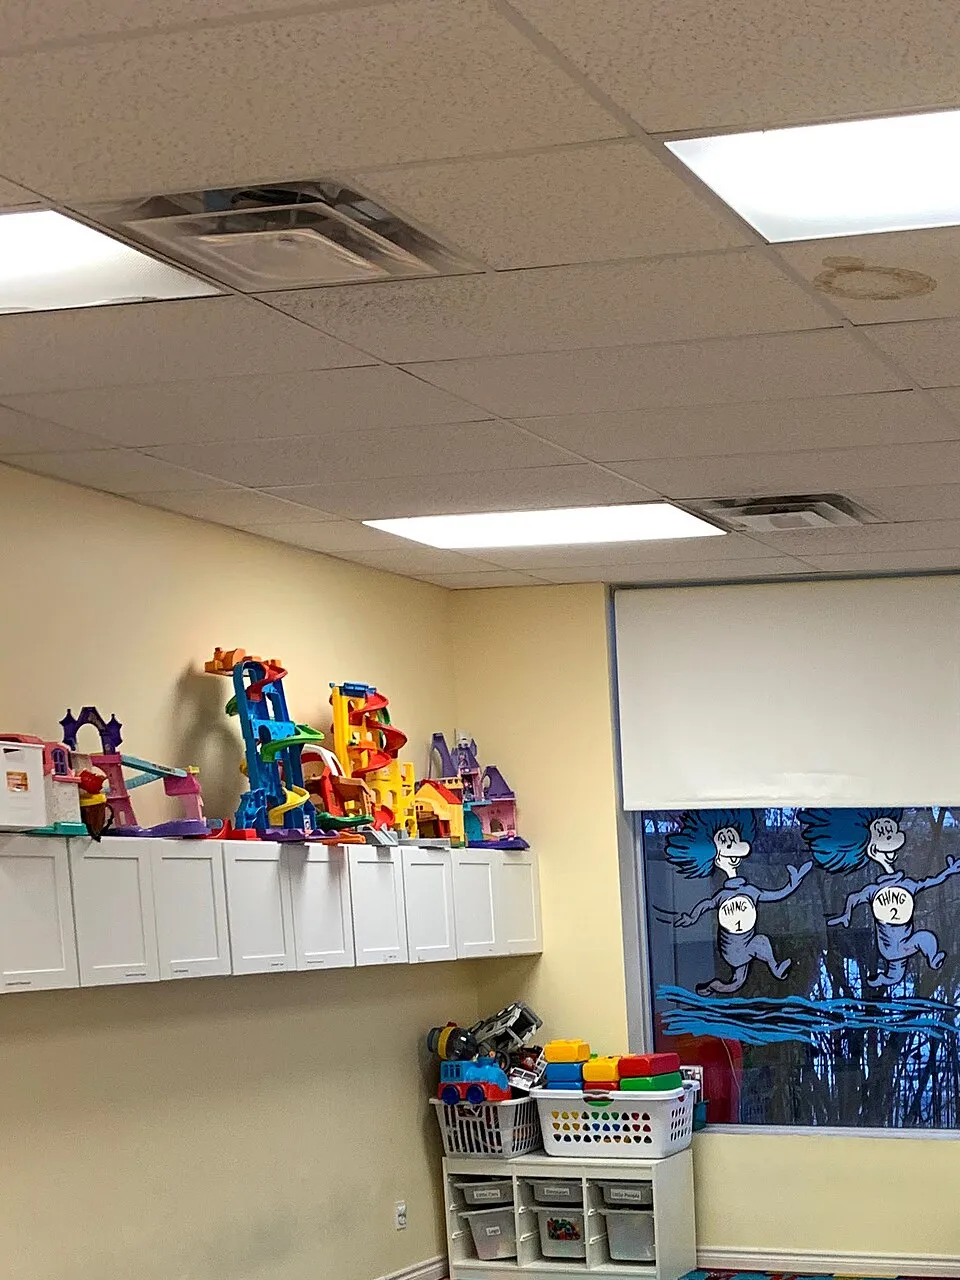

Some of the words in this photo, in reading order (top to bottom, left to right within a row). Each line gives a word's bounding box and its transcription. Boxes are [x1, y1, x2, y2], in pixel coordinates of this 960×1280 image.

[876, 889, 906, 906] THING
[722, 901, 748, 916] THING
[889, 908, 901, 920] 2
[734, 920, 743, 932] 1
